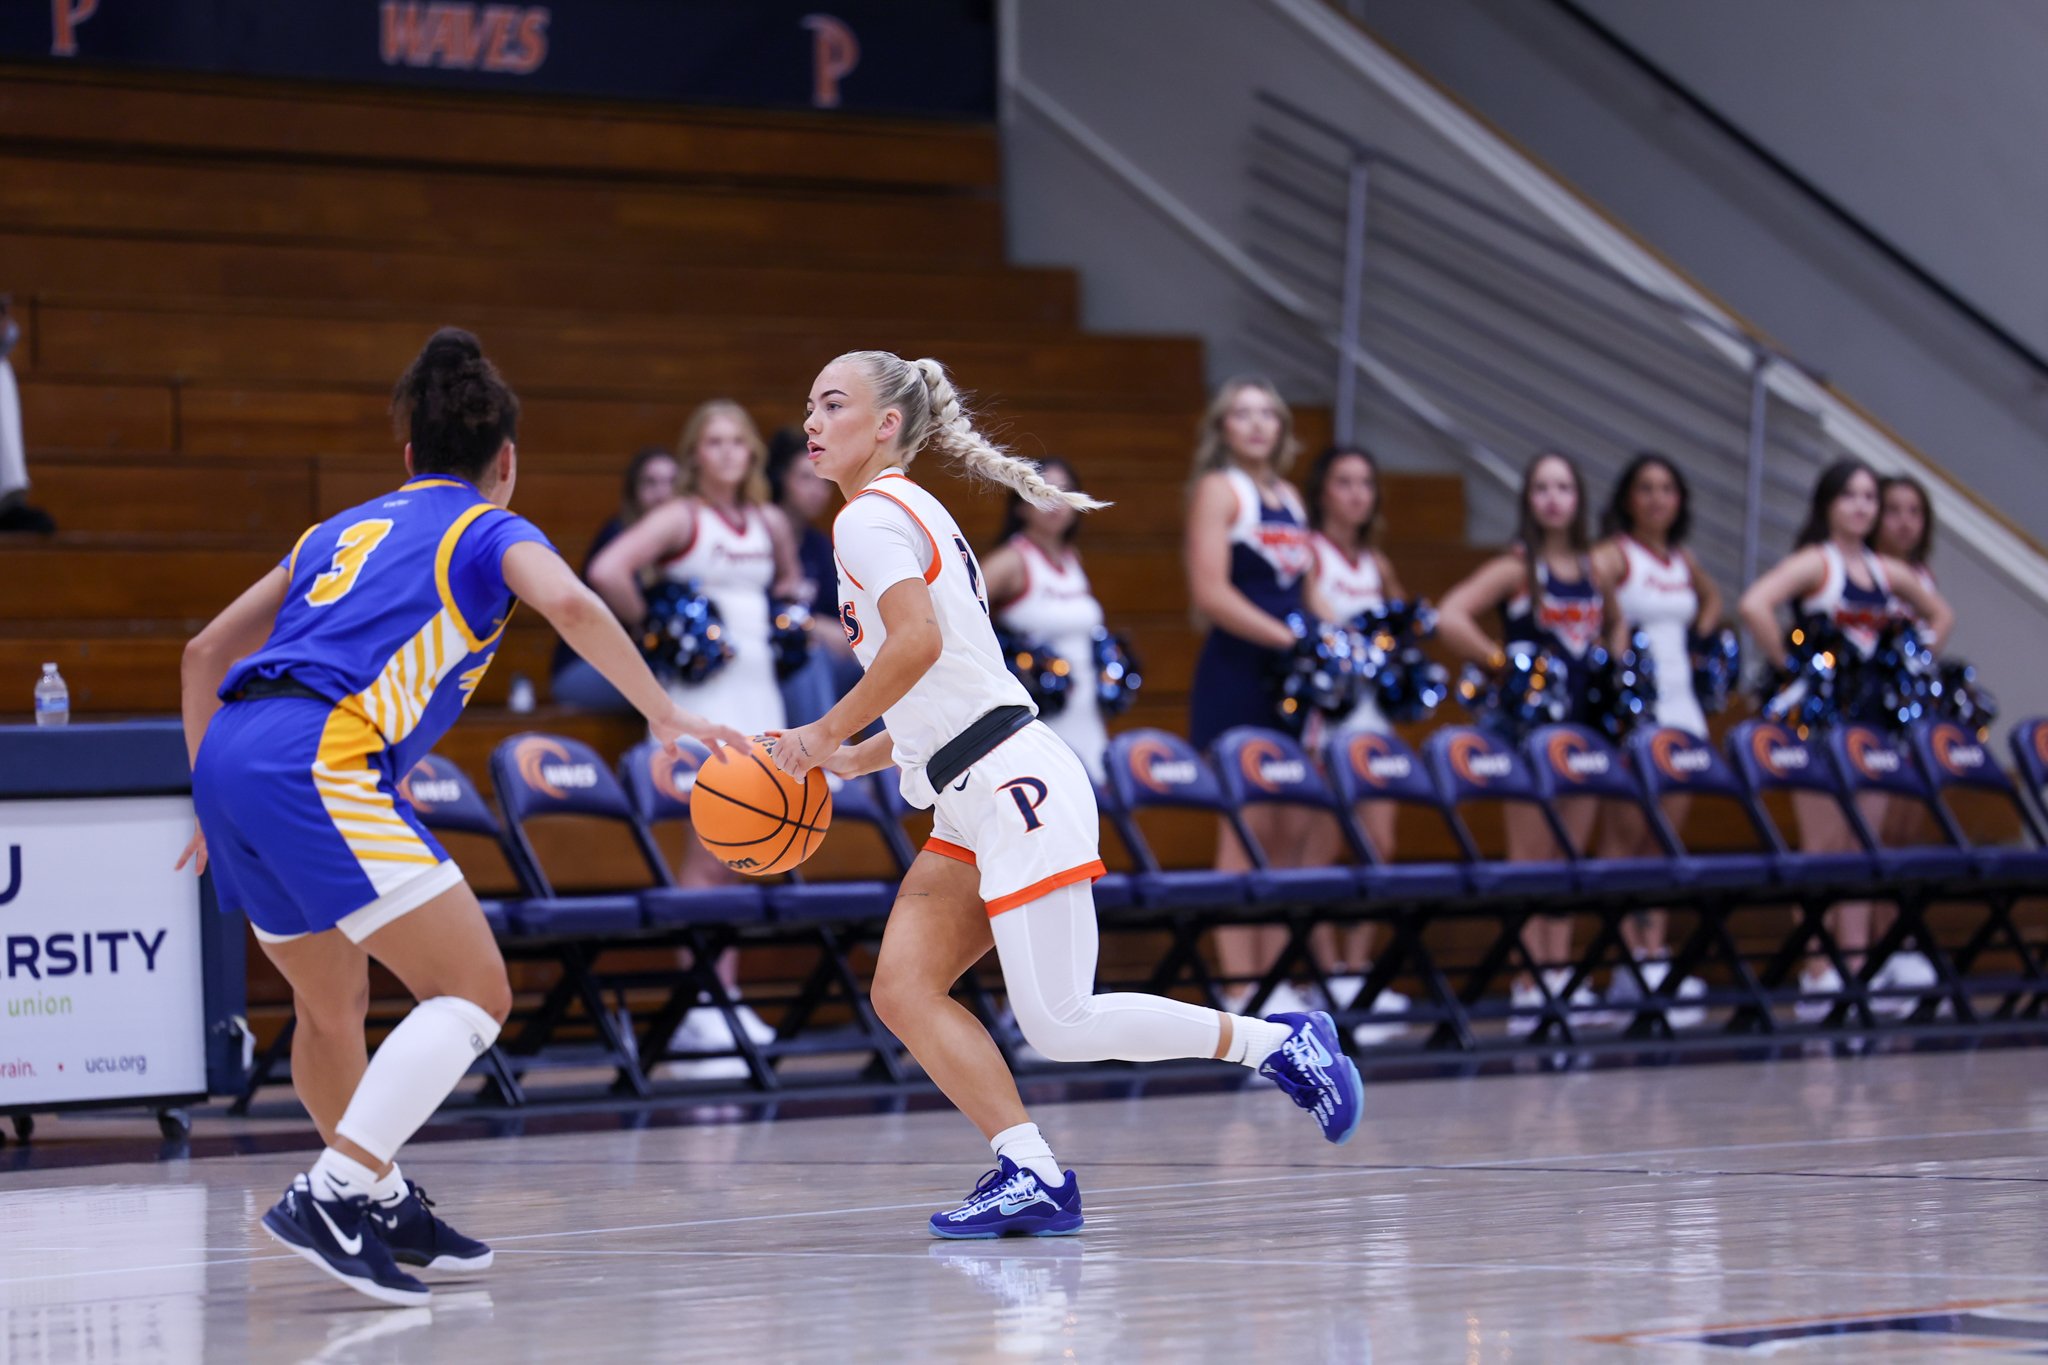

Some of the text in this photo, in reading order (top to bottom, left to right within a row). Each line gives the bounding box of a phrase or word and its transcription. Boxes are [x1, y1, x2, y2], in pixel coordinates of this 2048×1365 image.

[379, 2, 550, 74] WAVES
[800, 14, 860, 108] P
[304, 518, 394, 607] 3
[840, 600, 864, 649] S
[994, 776, 1047, 834] P
[0, 929, 167, 979] RSITY
[8, 991, 72, 1016] union
[0, 1054, 147, 1078] rain. ucu.org
